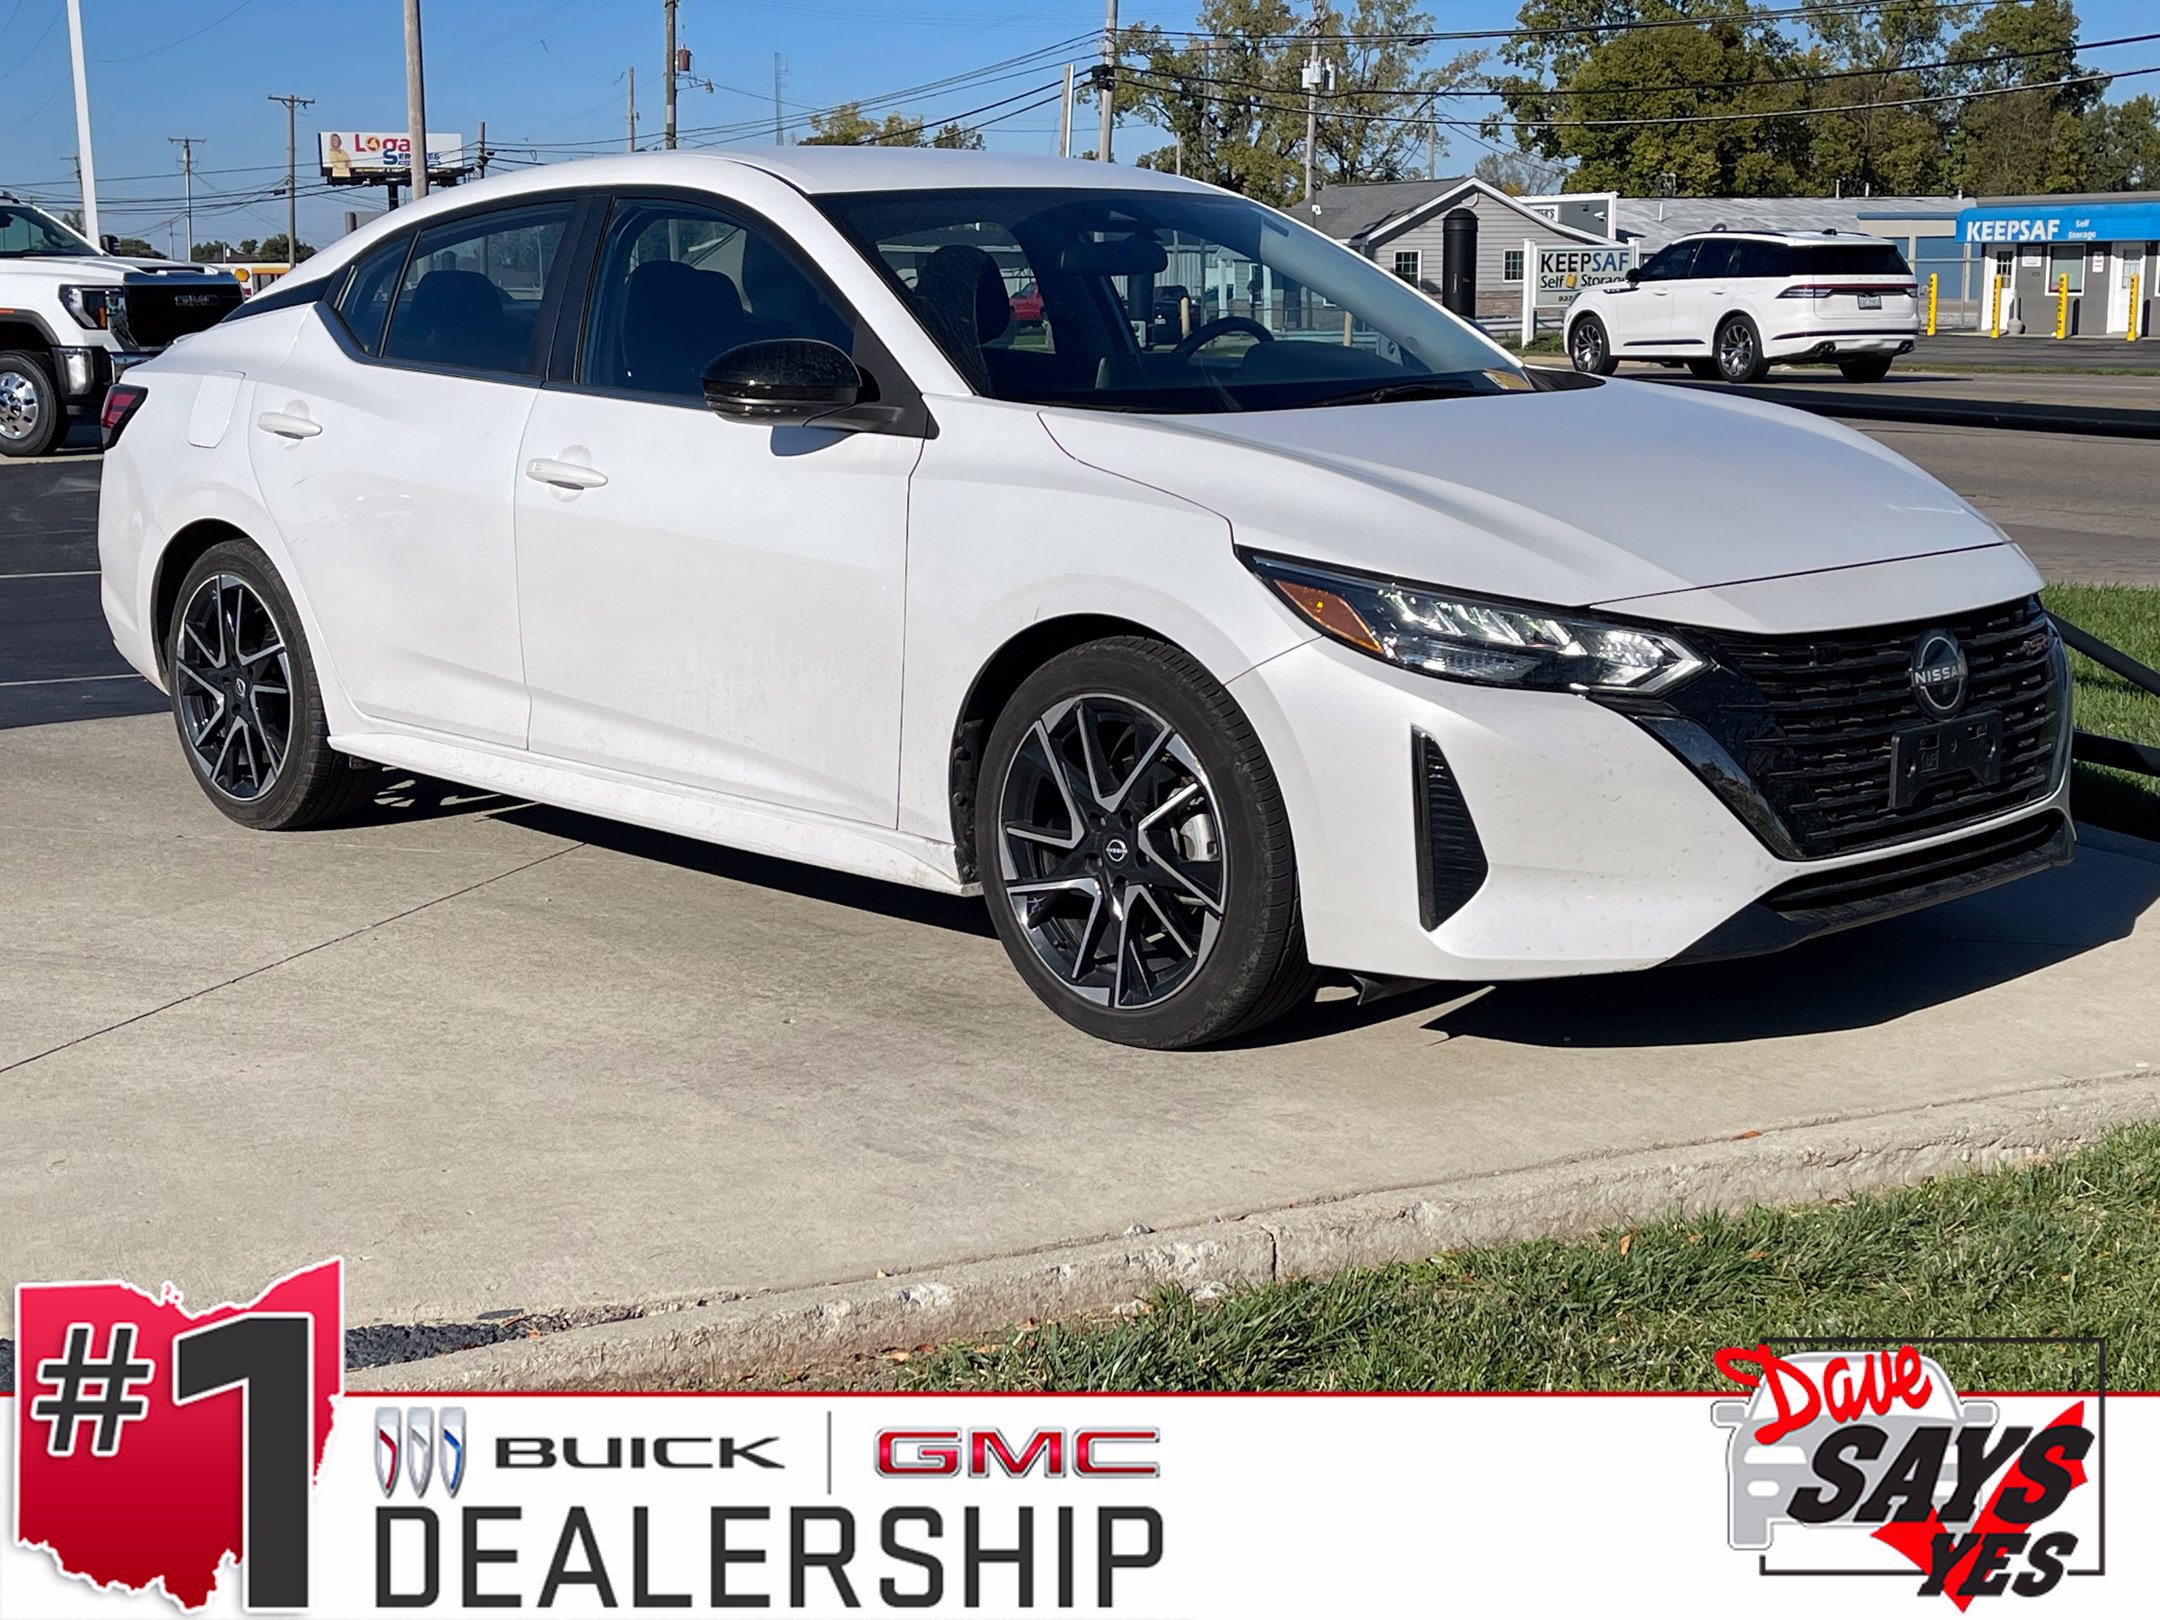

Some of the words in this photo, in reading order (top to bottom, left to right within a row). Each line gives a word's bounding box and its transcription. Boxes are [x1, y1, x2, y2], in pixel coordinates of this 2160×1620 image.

[354, 133, 412, 153] Loga
[1966, 219, 2060, 242] KEEPSAF
[2075, 219, 2090, 228] Self
[1540, 252, 1629, 273] KEEPSAF
[1540, 275, 1565, 288] Self
